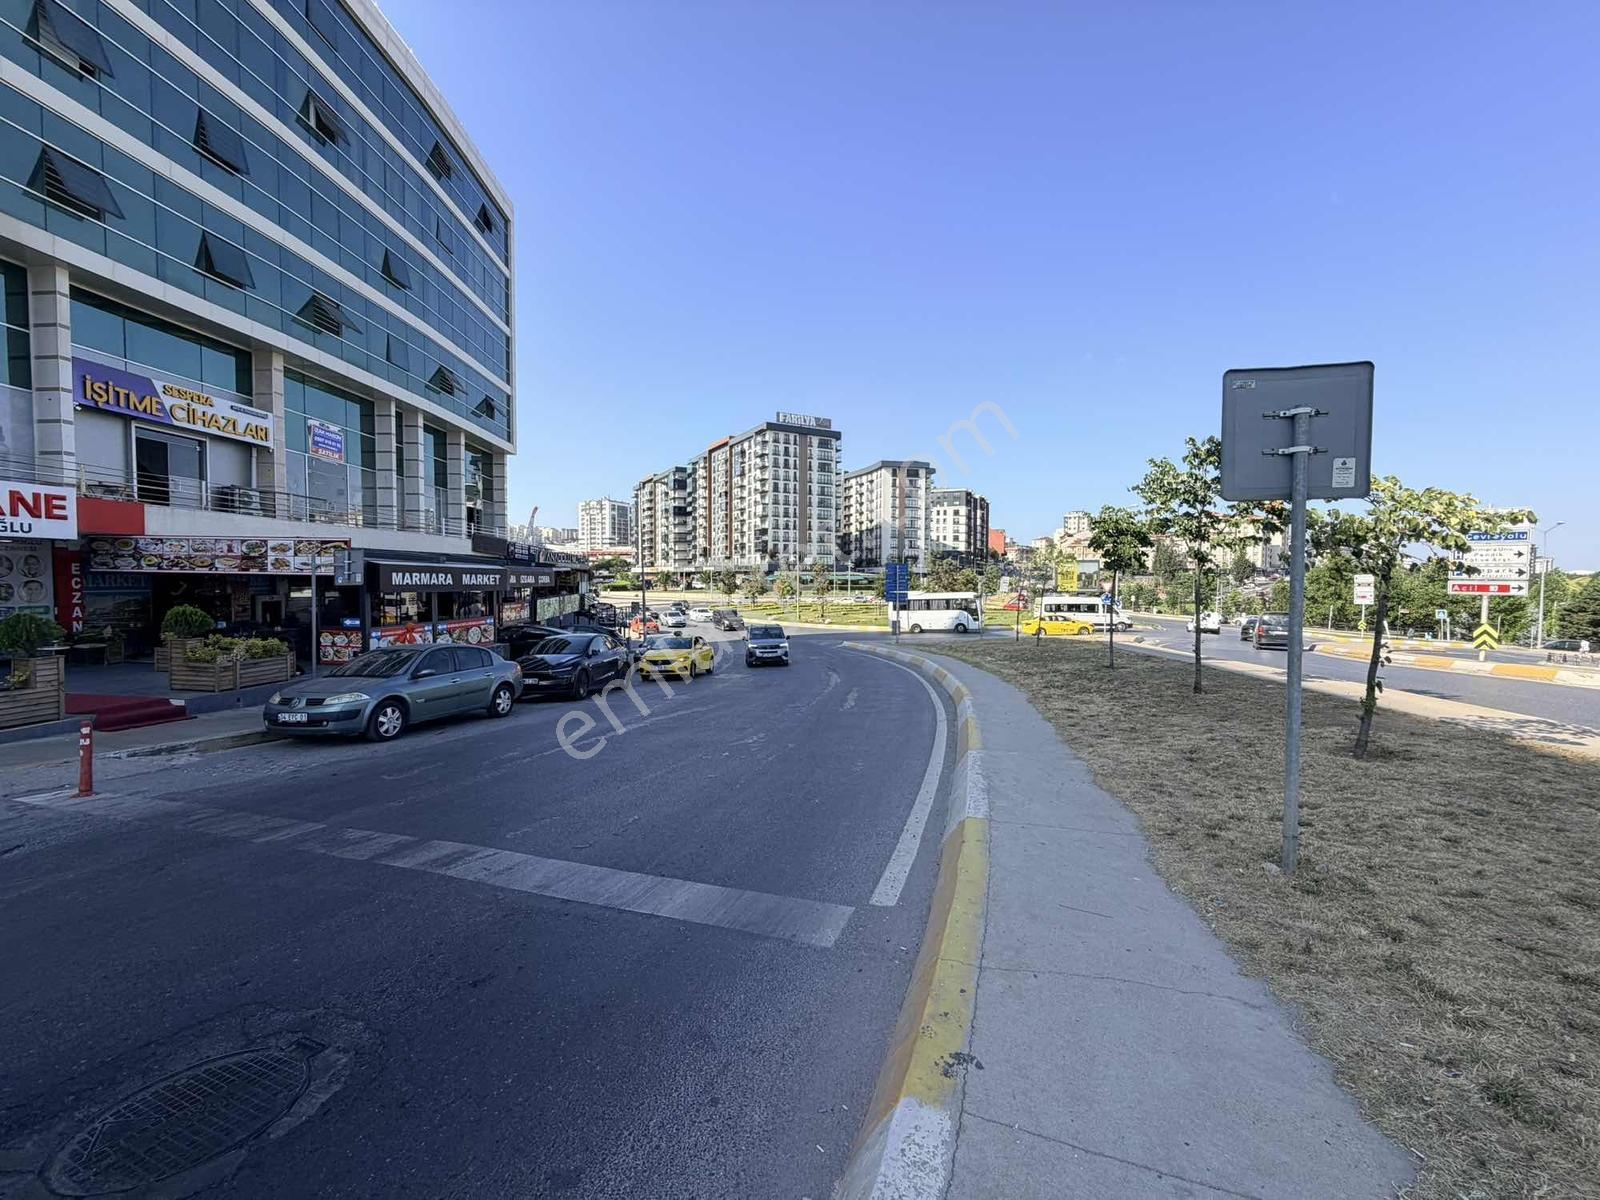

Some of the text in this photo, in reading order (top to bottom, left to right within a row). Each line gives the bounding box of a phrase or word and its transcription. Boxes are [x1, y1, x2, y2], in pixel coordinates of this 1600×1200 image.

[84, 374, 165, 417] İŞİTME
[171, 403, 270, 442] CİHAZLARI
[0, 490, 68, 521] NE
[71, 562, 83, 633] ECZAN
[391, 572, 453, 586] MARMARA
[462, 574, 501, 585] MARKET
